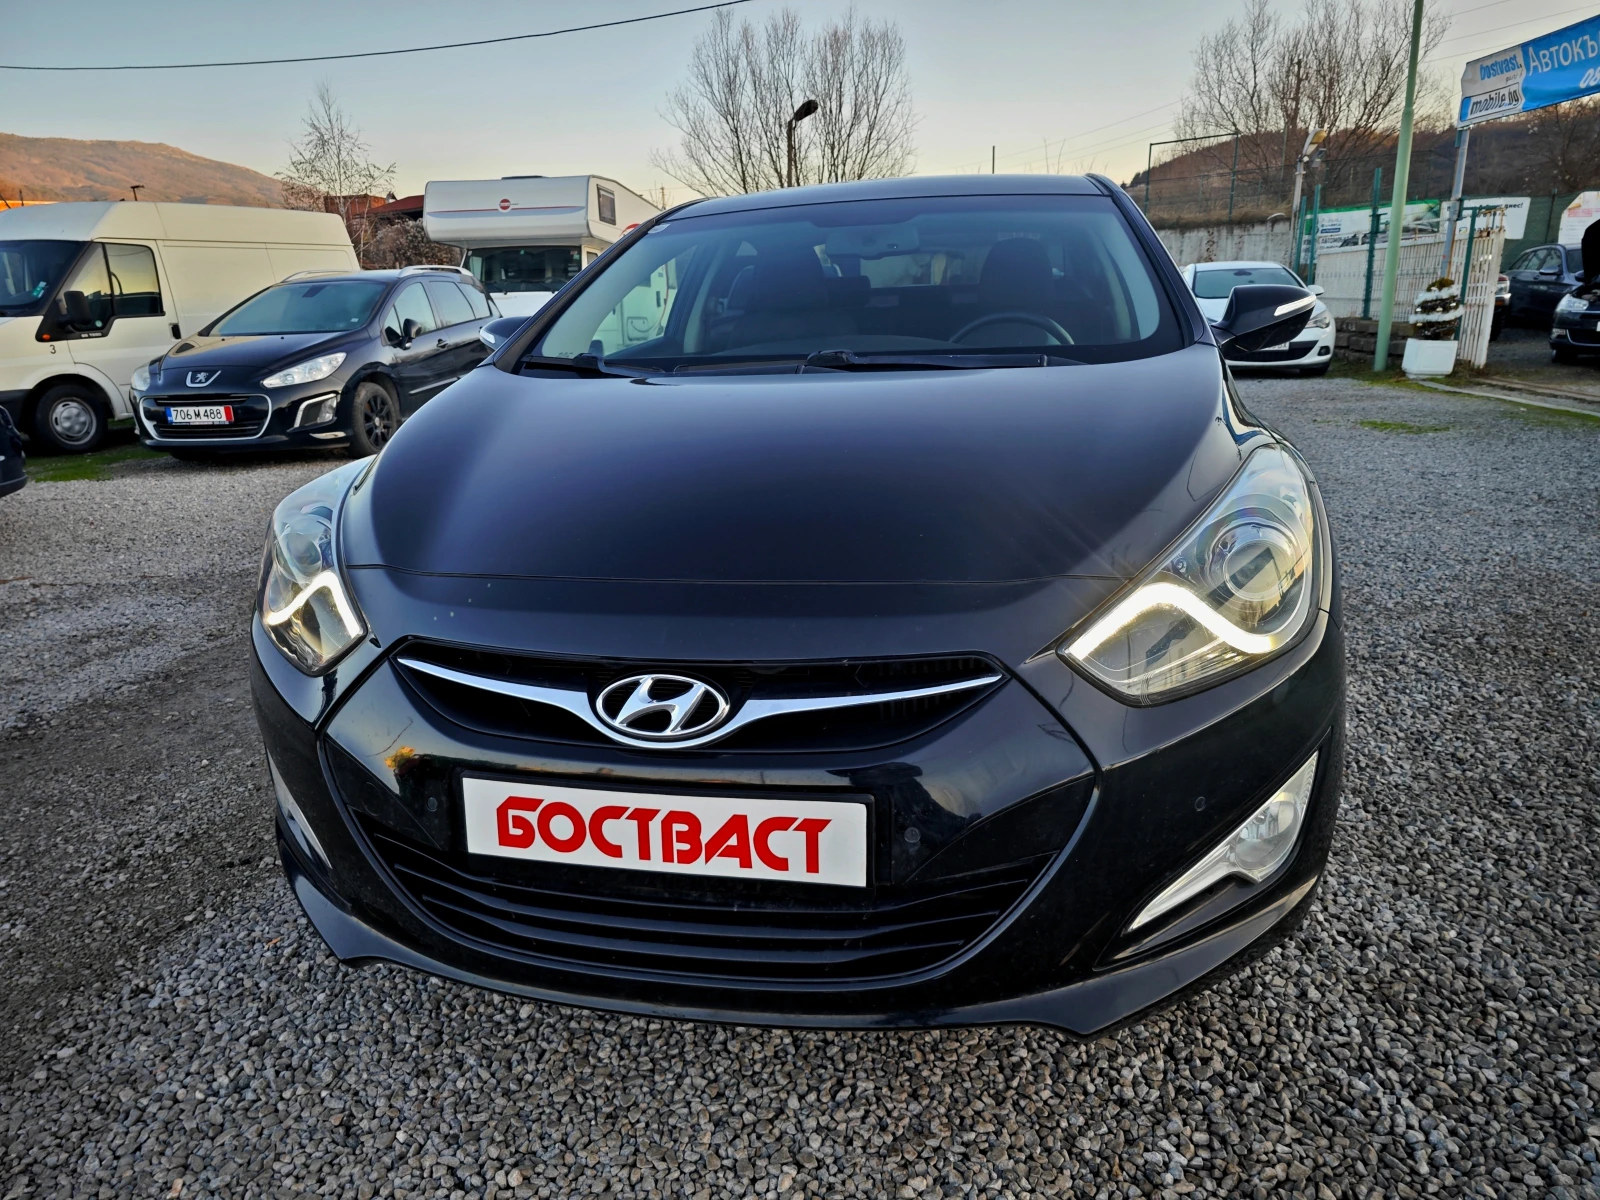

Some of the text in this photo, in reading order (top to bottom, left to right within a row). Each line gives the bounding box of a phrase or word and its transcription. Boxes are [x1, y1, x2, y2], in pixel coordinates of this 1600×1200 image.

[1528, 31, 1600, 76] АВТОКЪ
[1470, 88, 1519, 115] mobile.bg
[49, 344, 57, 355] 3
[173, 408, 222, 420] 706 M 488
[496, 795, 832, 874] БОСТВАСТ
